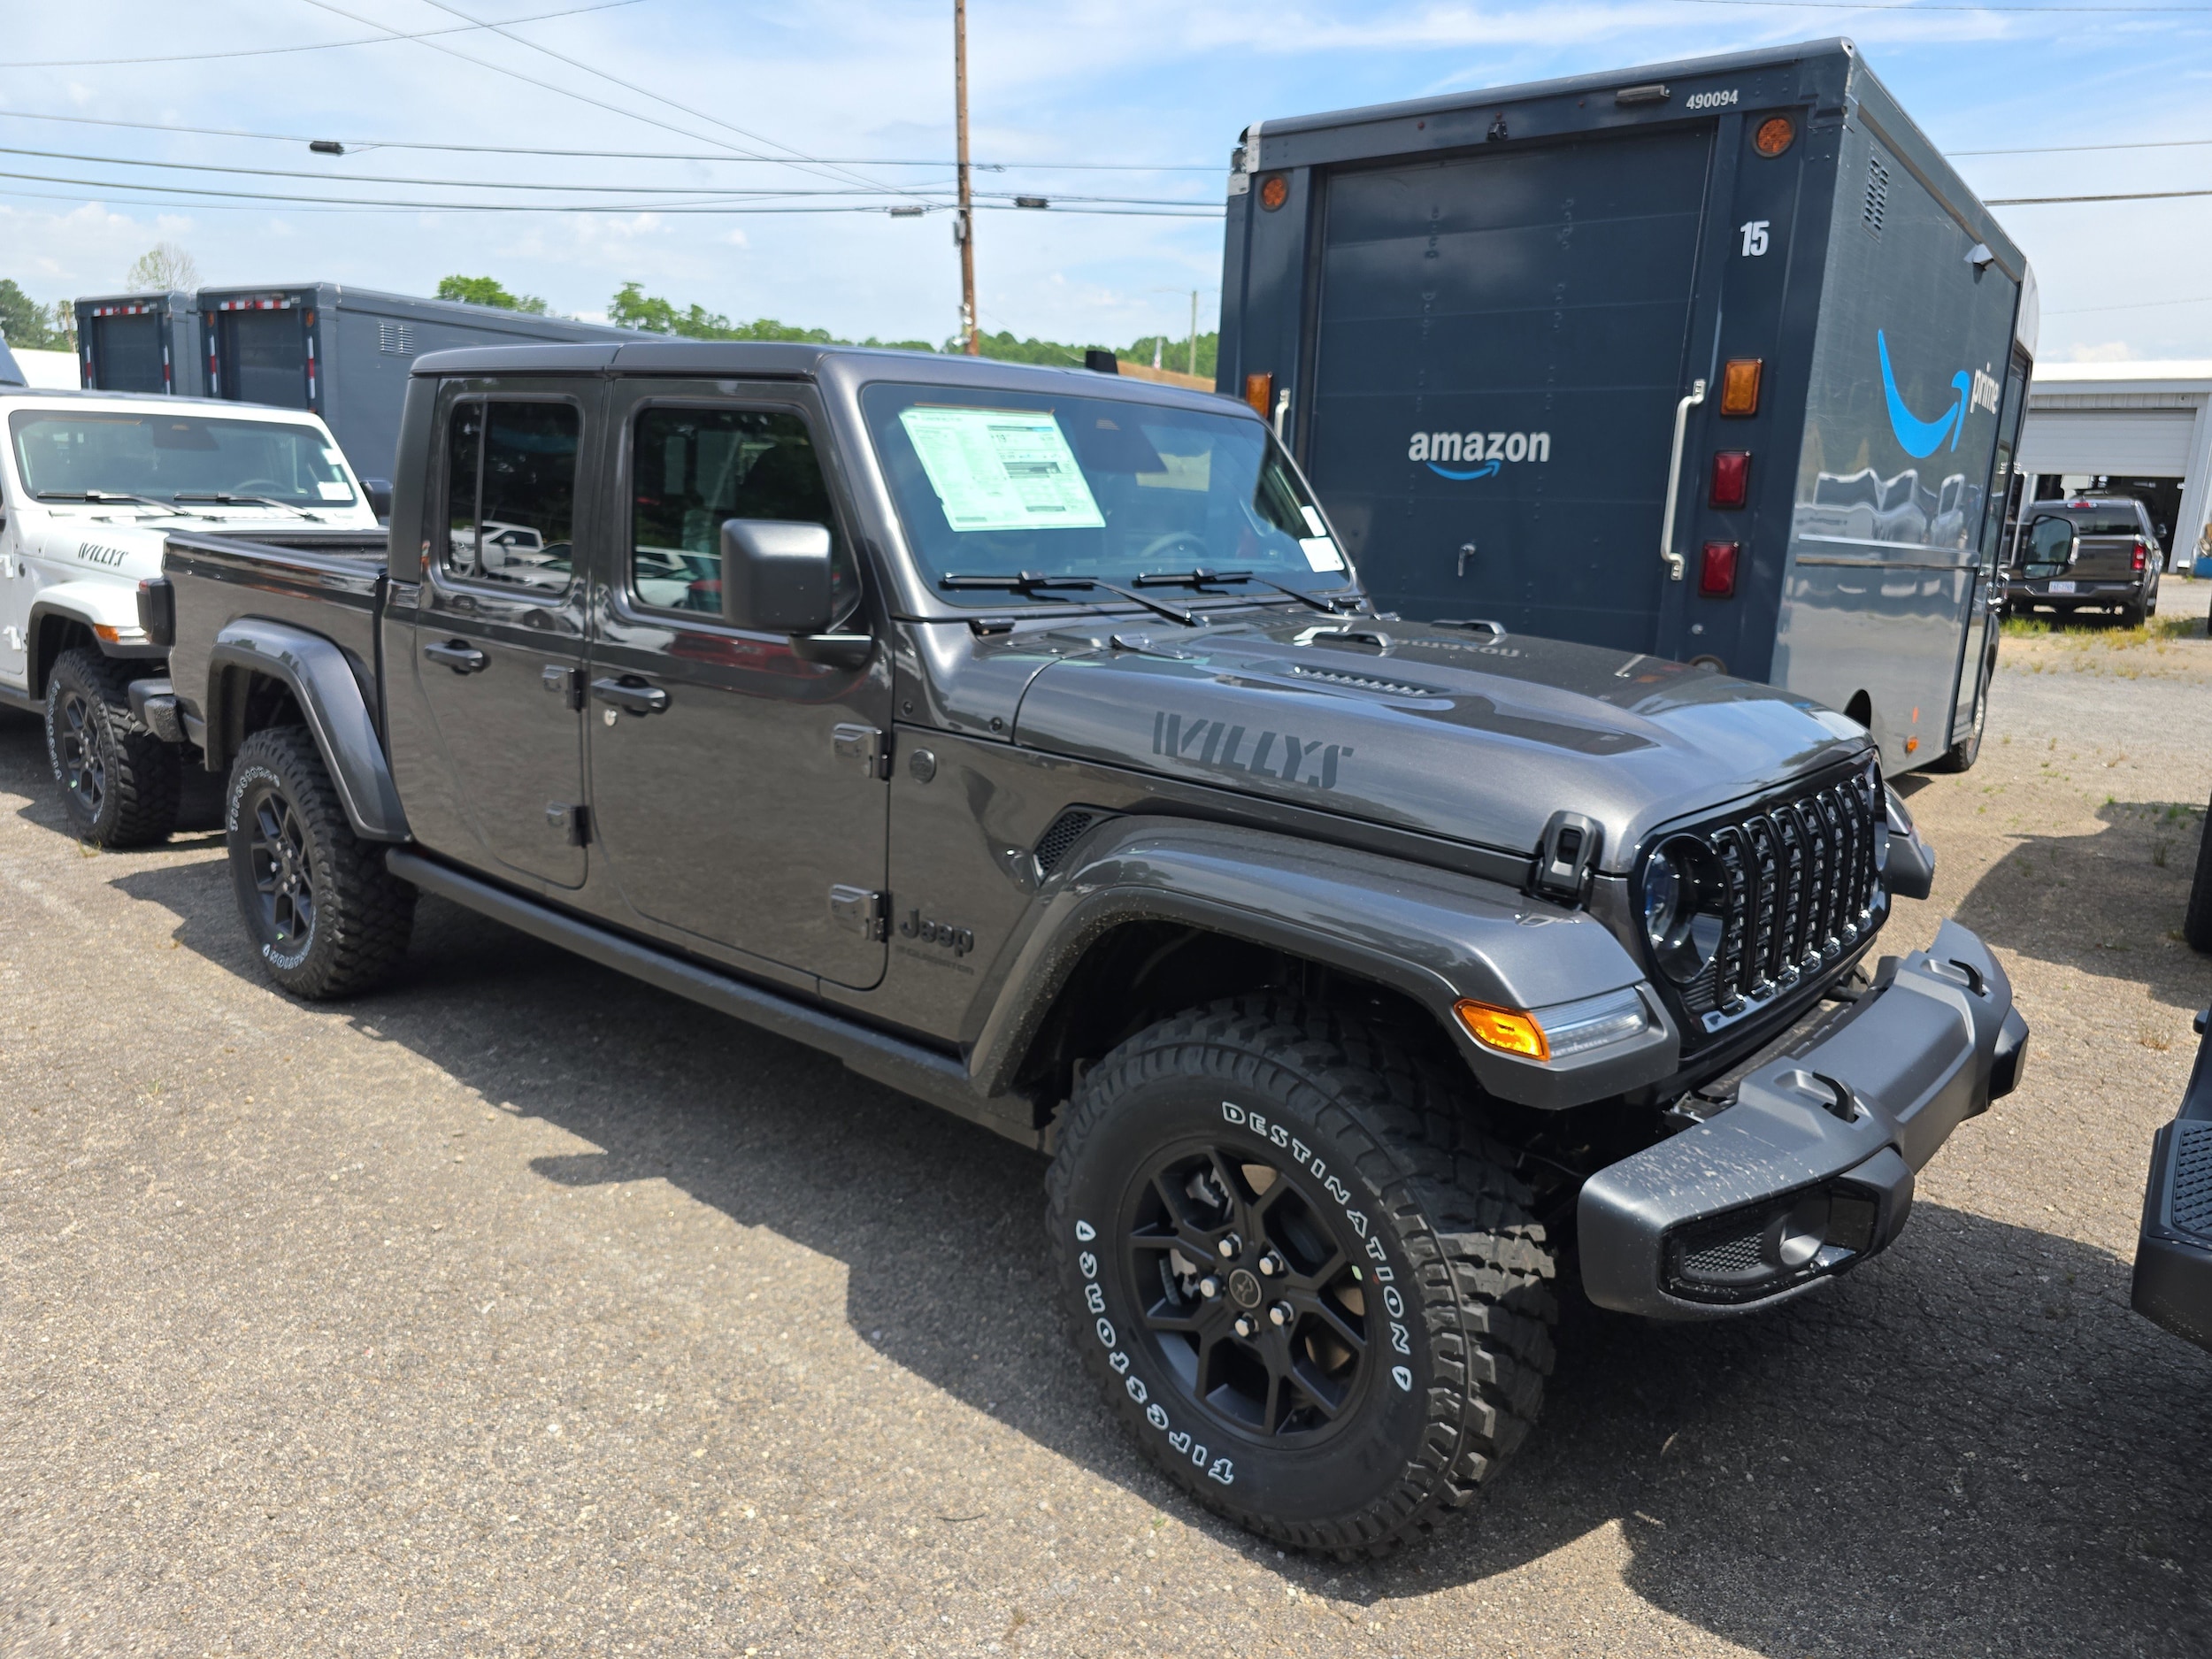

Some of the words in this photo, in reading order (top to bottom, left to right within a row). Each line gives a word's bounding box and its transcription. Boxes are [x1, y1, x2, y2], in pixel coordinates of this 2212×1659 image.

[1686, 89, 1739, 110] 490094
[1740, 220, 1770, 257] 15
[1970, 361, 2000, 415] prime
[1409, 431, 1551, 463] amazon
[78, 541, 129, 568] WILLYS
[1152, 710, 1355, 790] WILLYS
[899, 909, 974, 957] Jeep
[1222, 1101, 1411, 1356] DESTINATION
